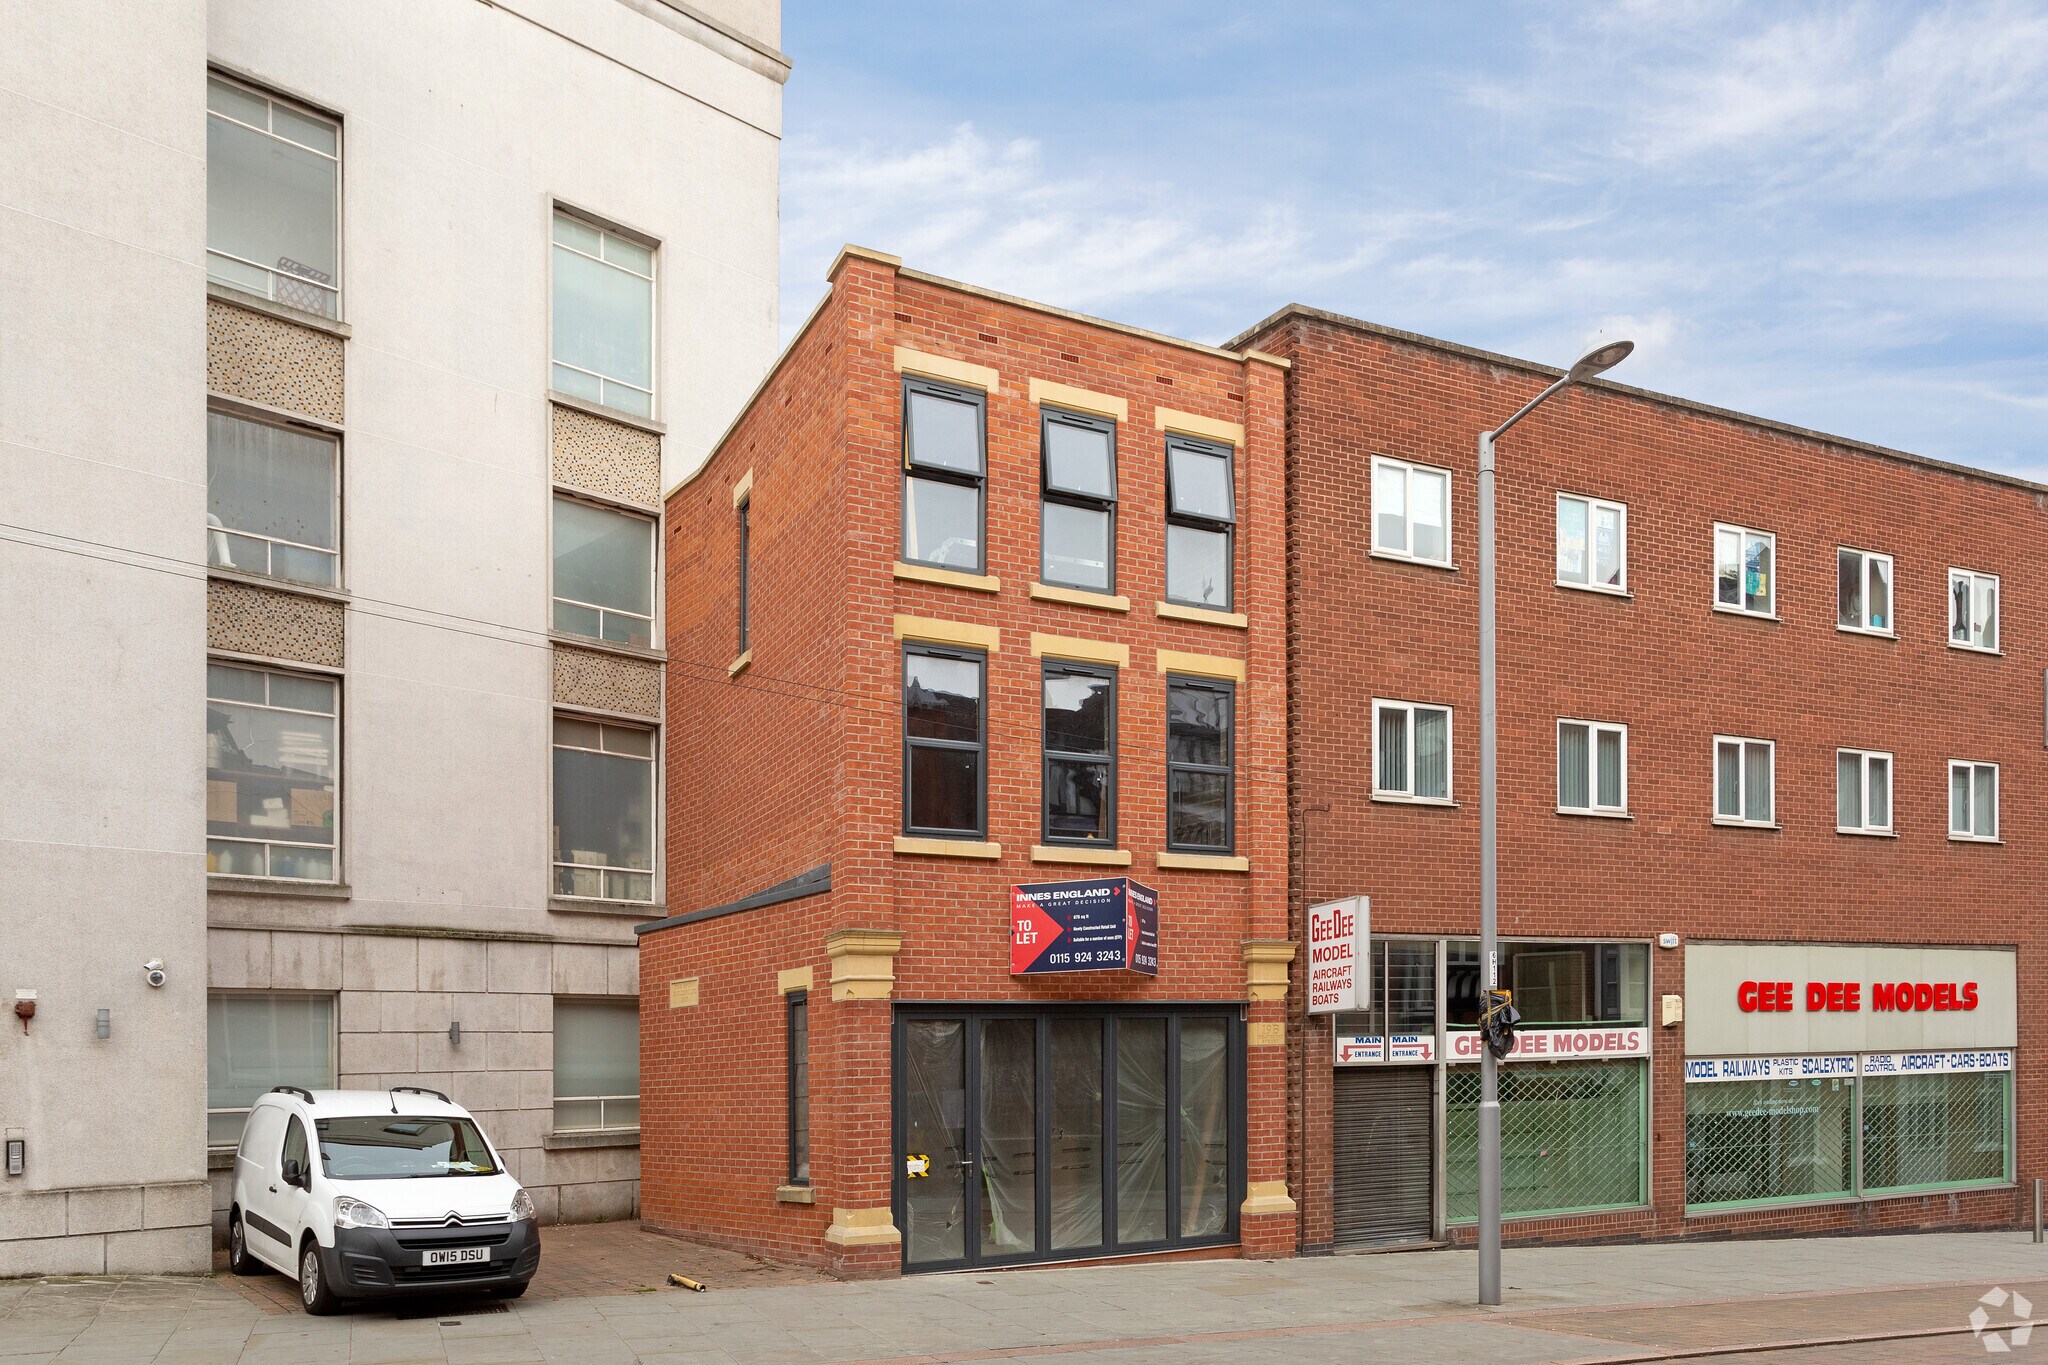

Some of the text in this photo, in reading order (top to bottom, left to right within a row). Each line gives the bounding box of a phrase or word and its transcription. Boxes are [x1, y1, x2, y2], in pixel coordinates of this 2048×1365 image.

[1016, 888, 1110, 902] INNES ENGLAND
[1017, 920, 1032, 931] TO
[1016, 932, 1038, 944] LET
[1663, 936, 1677, 945] swift
[1050, 950, 1121, 964] 0115 924 3243
[1312, 943, 1353, 963] MODEL
[1313, 965, 1352, 980] AIRCRAFT
[1312, 978, 1352, 993] RAILWAYS
[1312, 993, 1339, 1006] BOATS
[1738, 980, 1978, 1012] GEE DEE MODELS
[1455, 1035, 1481, 1055] GE
[1554, 1031, 1639, 1053] MODELS
[1773, 1058, 1799, 1066] PLASTIC
[1802, 1057, 1854, 1074] SCALEXTRIC
[1870, 1055, 1891, 1063] RADIO
[1901, 1054, 1945, 1070] AIRCRAFT
[1685, 1059, 1770, 1078] MODEL RAILWAYS
[1779, 1067, 1793, 1076] KITS
[1864, 1063, 1897, 1072] CONTROL
[430, 1249, 483, 1263] OW15 DSU
